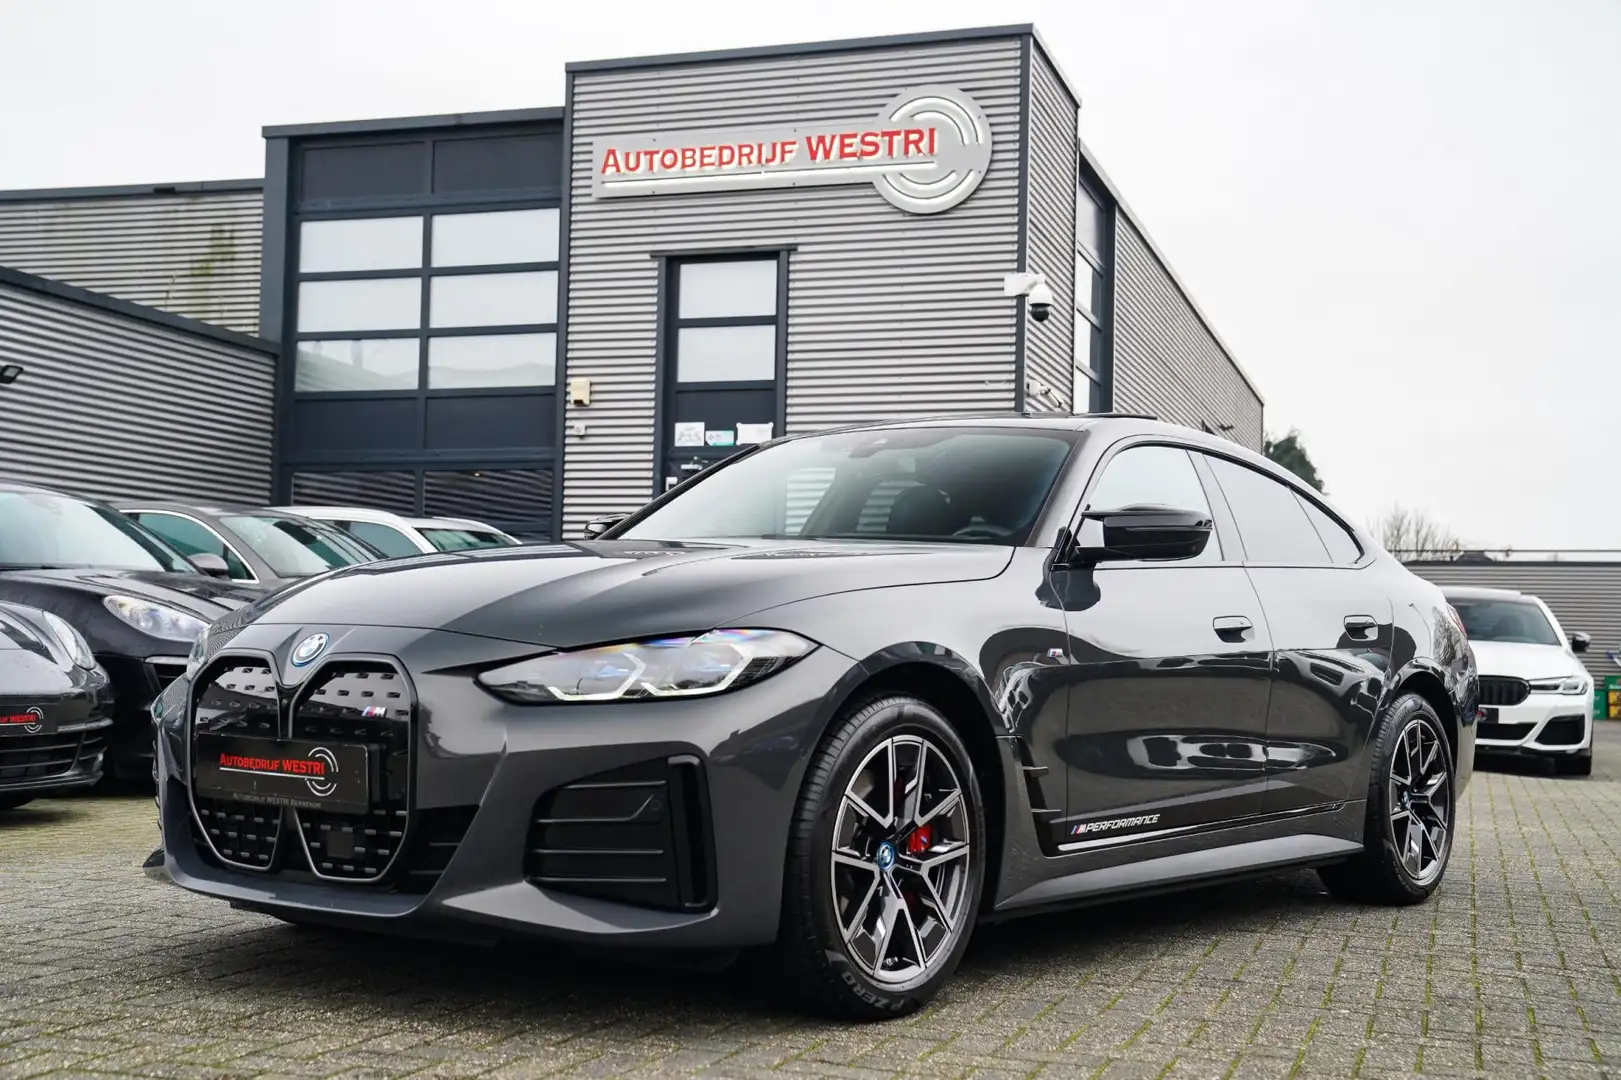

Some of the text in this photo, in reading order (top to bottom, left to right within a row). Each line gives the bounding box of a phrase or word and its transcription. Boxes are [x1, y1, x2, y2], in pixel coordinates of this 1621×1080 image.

[600, 127, 937, 174] AUTOBEDRIJF WESTRI
[219, 753, 325, 775] AUTOBEDRIJF WESTRI
